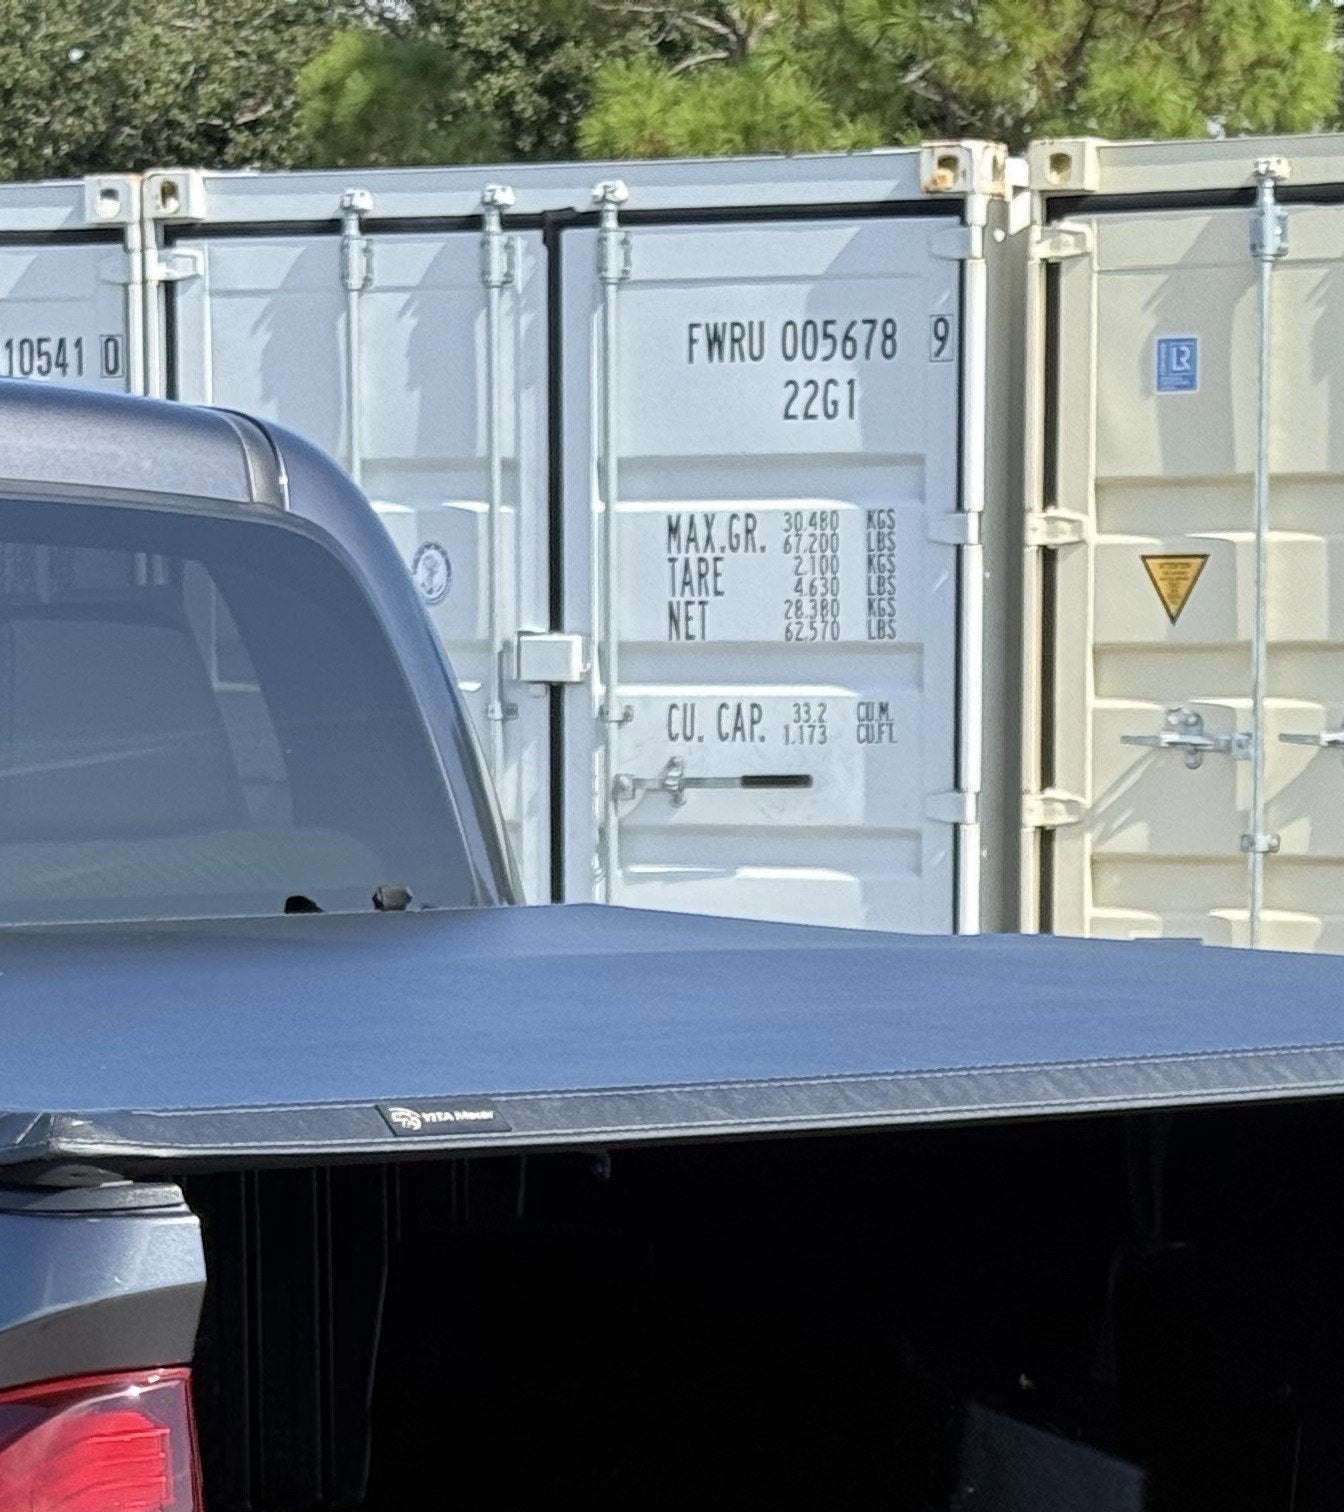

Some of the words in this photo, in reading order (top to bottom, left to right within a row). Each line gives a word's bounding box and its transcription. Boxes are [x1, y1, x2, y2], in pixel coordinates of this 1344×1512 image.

[687, 321, 766, 364] FWRU
[781, 318, 898, 362] 005678
[932, 317, 949, 359] 9
[783, 378, 858, 421] 22G1
[867, 509, 895, 531] KGS
[867, 531, 895, 553] LBS
[867, 555, 895, 575] KGS
[668, 556, 725, 598] TARE
[867, 576, 895, 596] LBS
[867, 598, 897, 618] KGS
[667, 600, 710, 641] NET
[867, 619, 897, 640] LBS
[667, 703, 704, 743] CU.
[717, 702, 767, 743] CAP.
